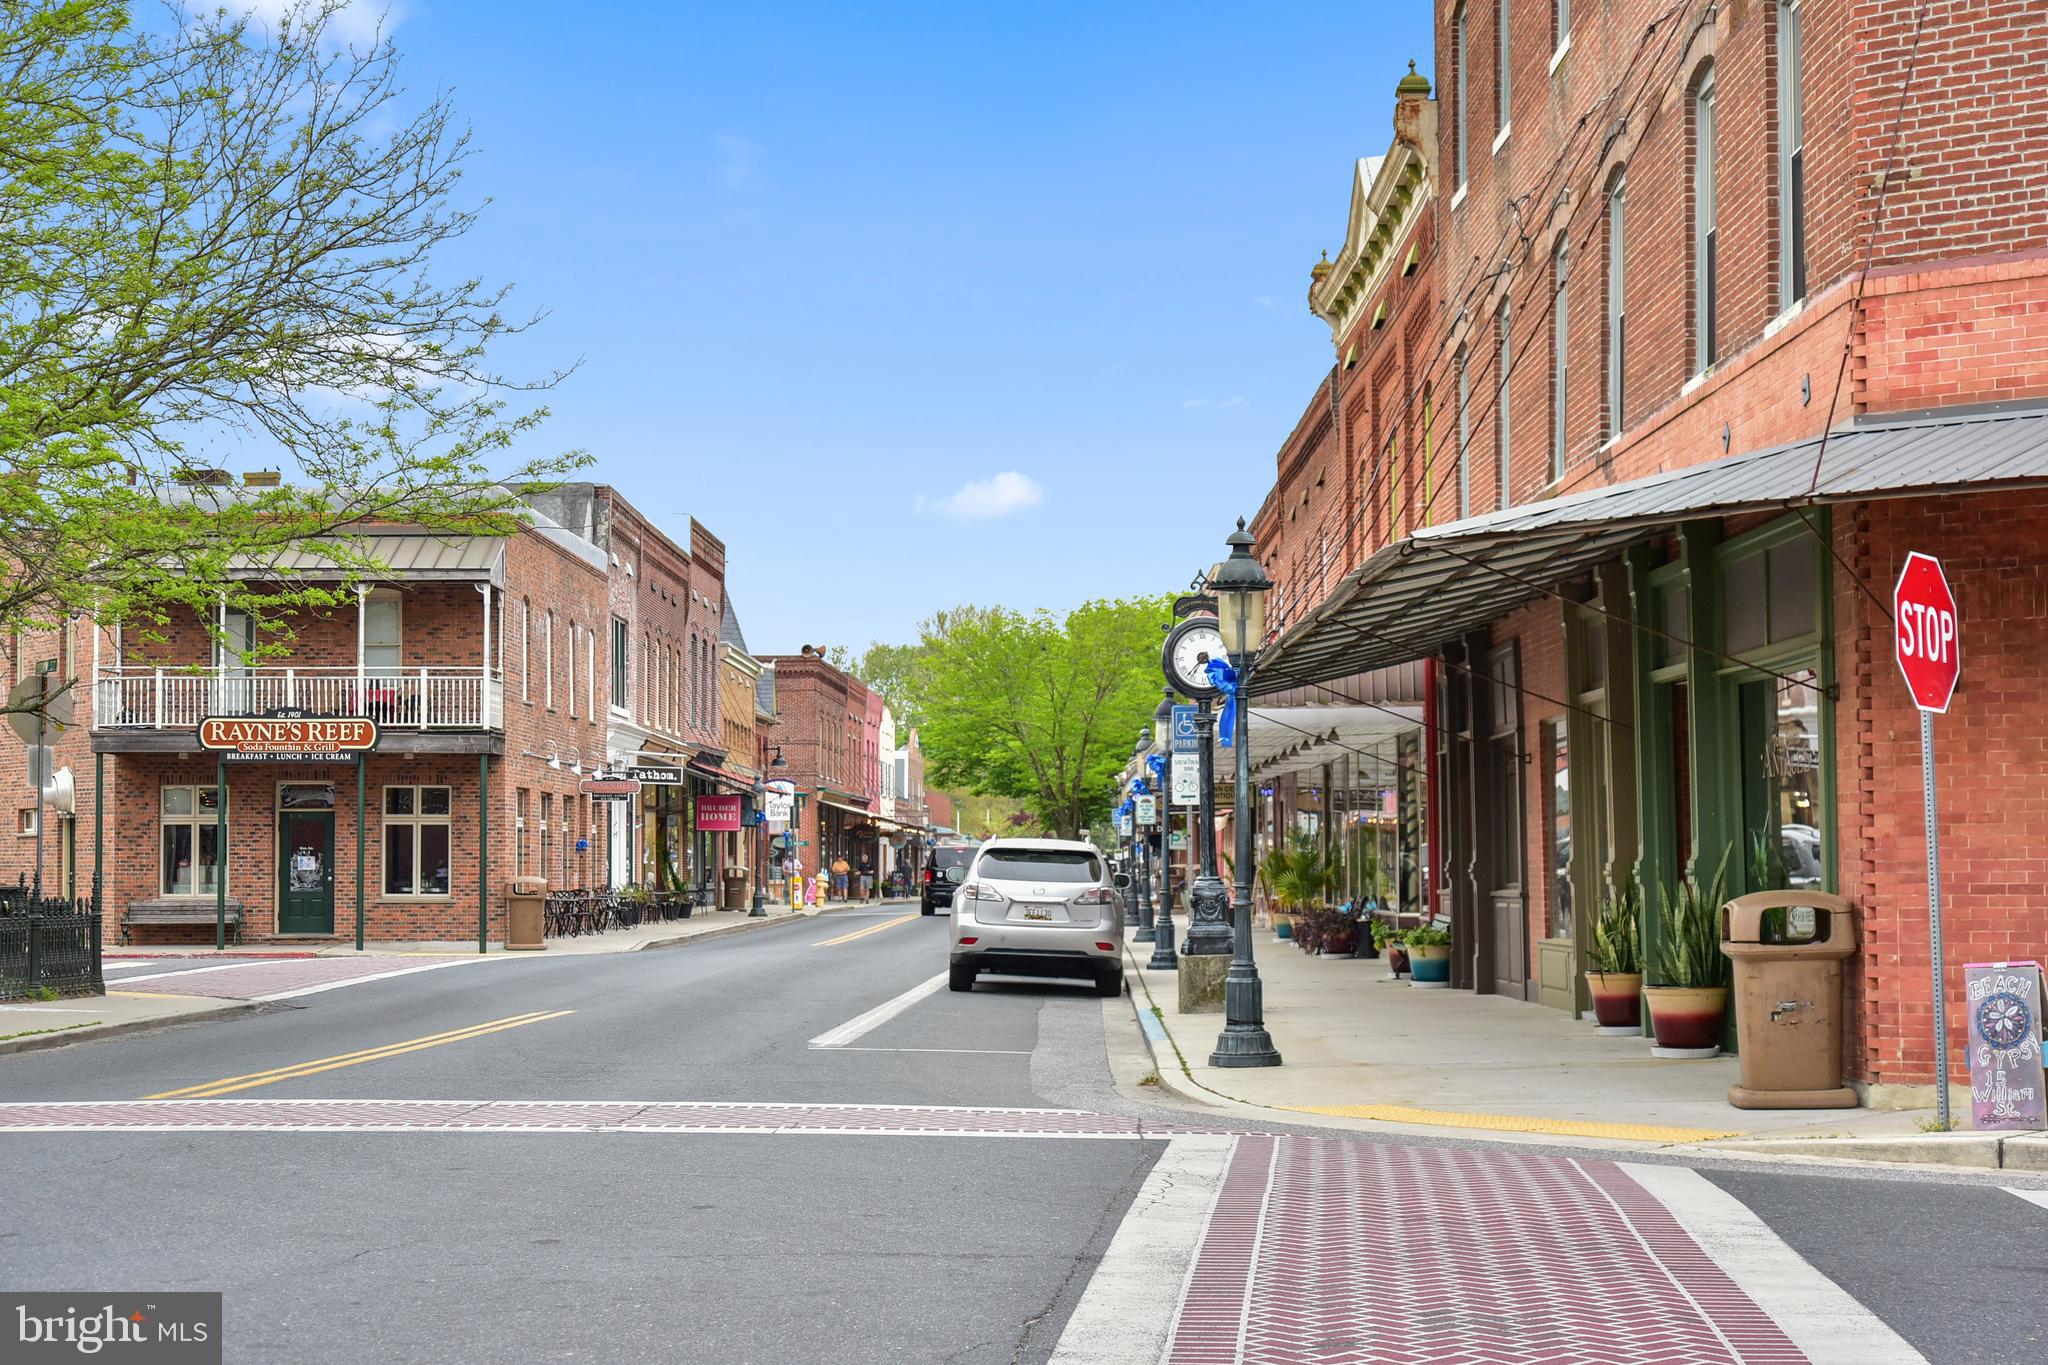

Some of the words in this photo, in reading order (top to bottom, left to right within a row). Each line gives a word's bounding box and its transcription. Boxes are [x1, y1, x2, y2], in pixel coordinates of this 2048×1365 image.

[1901, 600, 1953, 663] STOP
[210, 722, 301, 741] RAYNE'S
[307, 722, 365, 741] REEF
[243, 743, 262, 751] Soda
[263, 743, 300, 751] Fountain
[303, 743, 312, 751] &
[313, 743, 335, 751] Grill
[1174, 739, 1198, 749] PARKIN
[701, 812, 736, 821] HOME
[770, 809, 789, 817] Bank
[1969, 975, 2032, 1001] BEACH
[1977, 1031, 2041, 1069] GYPSY
[1986, 1070, 2007, 1087] 15
[1972, 1086, 2034, 1104] William
[1993, 1101, 2020, 1117] St.
